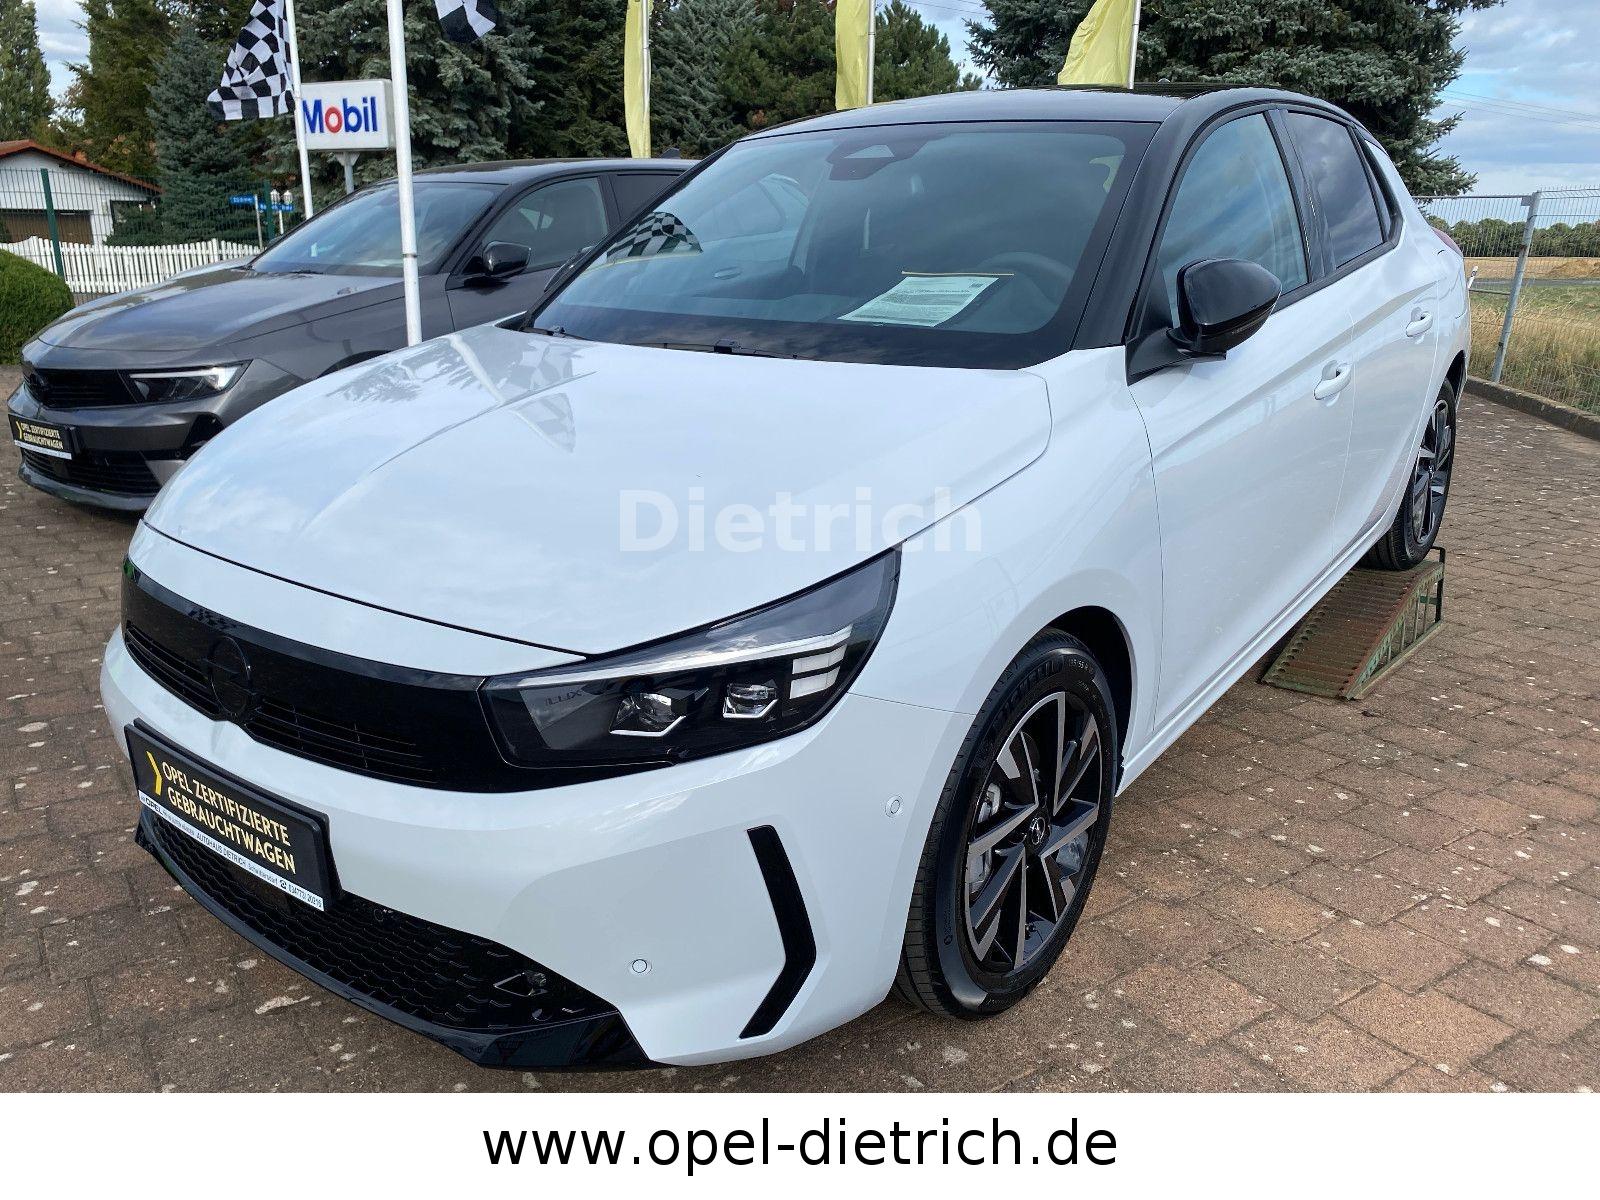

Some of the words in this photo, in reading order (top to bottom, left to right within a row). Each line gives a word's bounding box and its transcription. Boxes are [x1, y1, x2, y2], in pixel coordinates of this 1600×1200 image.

[303, 96, 377, 134] Mobil
[145, 797, 164, 816] OPEL
[196, 832, 223, 853] AUTOHAUS
[223, 848, 247, 867] DIETRICH
[161, 761, 193, 795] OPEL
[193, 778, 291, 847] ZERTIFIZIERTE
[167, 786, 296, 875] GEBRAUCHTWAGEN
